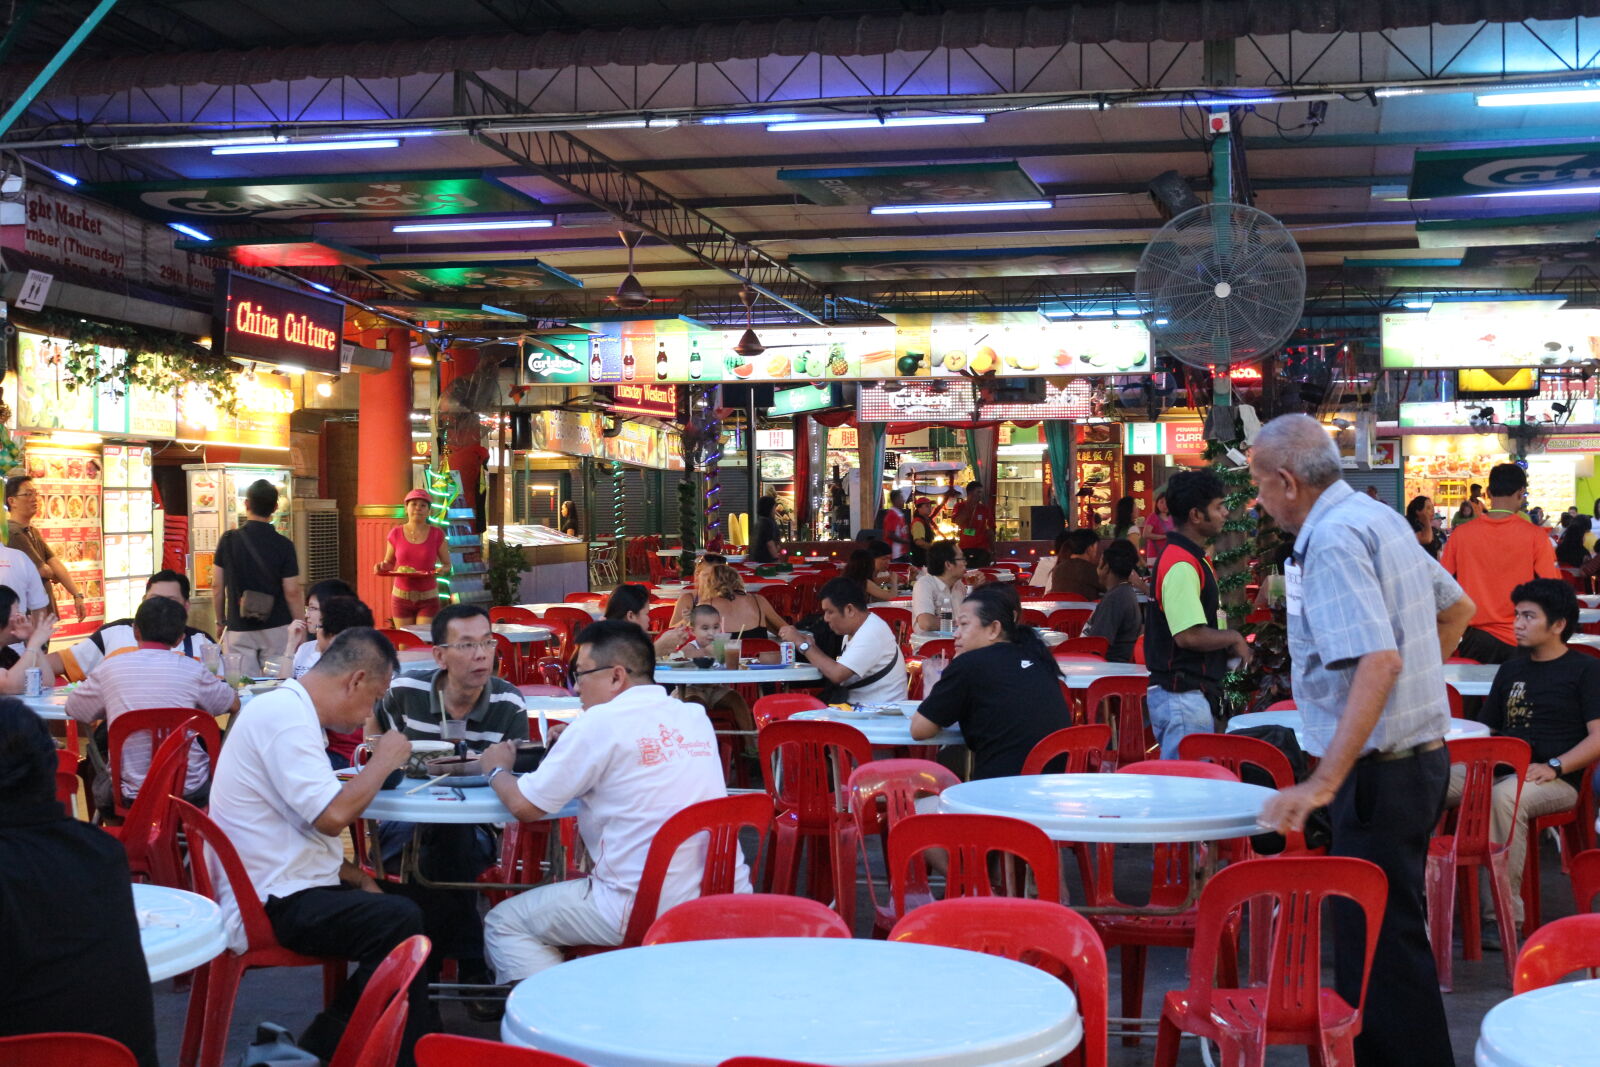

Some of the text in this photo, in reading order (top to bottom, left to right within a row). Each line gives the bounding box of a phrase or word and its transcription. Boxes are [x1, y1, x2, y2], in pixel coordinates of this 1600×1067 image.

[55, 202, 102, 236] Market
[140, 190, 478, 219] Carlsberg
[64, 236, 125, 269] (Thursday)
[160, 265, 183, 283] 29th
[237, 302, 336, 351] China Culture
[889, 388, 951, 413] Carlsberg
